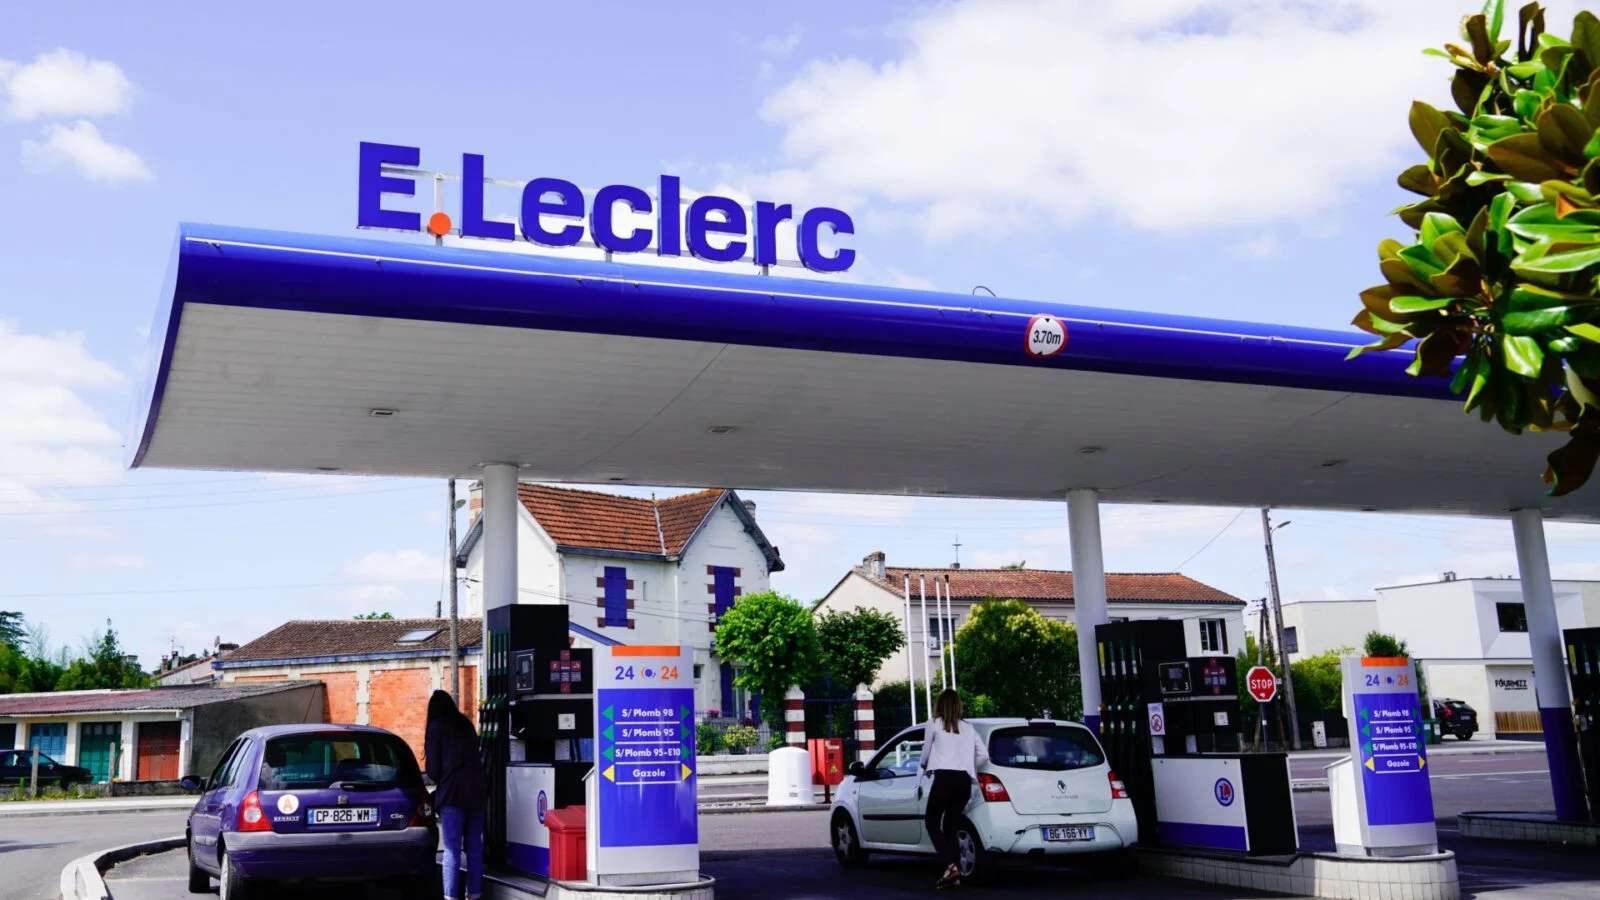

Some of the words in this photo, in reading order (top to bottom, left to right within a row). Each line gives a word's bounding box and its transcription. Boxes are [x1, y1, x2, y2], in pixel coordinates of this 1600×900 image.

[357, 141, 856, 273] E.Leclerc
[1033, 330, 1061, 344] 3.70m
[615, 665, 634, 680] 24
[661, 665, 679, 680] 24
[1251, 679, 1272, 689] STOP
[1365, 674, 1380, 686] 24
[1397, 673, 1409, 686] 24
[663, 708, 674, 717] 98
[1402, 709, 1410, 717] 98
[663, 728, 674, 736] 95
[653, 748, 681, 757] 95-E10
[1387, 760, 1410, 768] Gazole
[632, 768, 666, 778] Gazole
[316, 809, 370, 823] CP-826-WM
